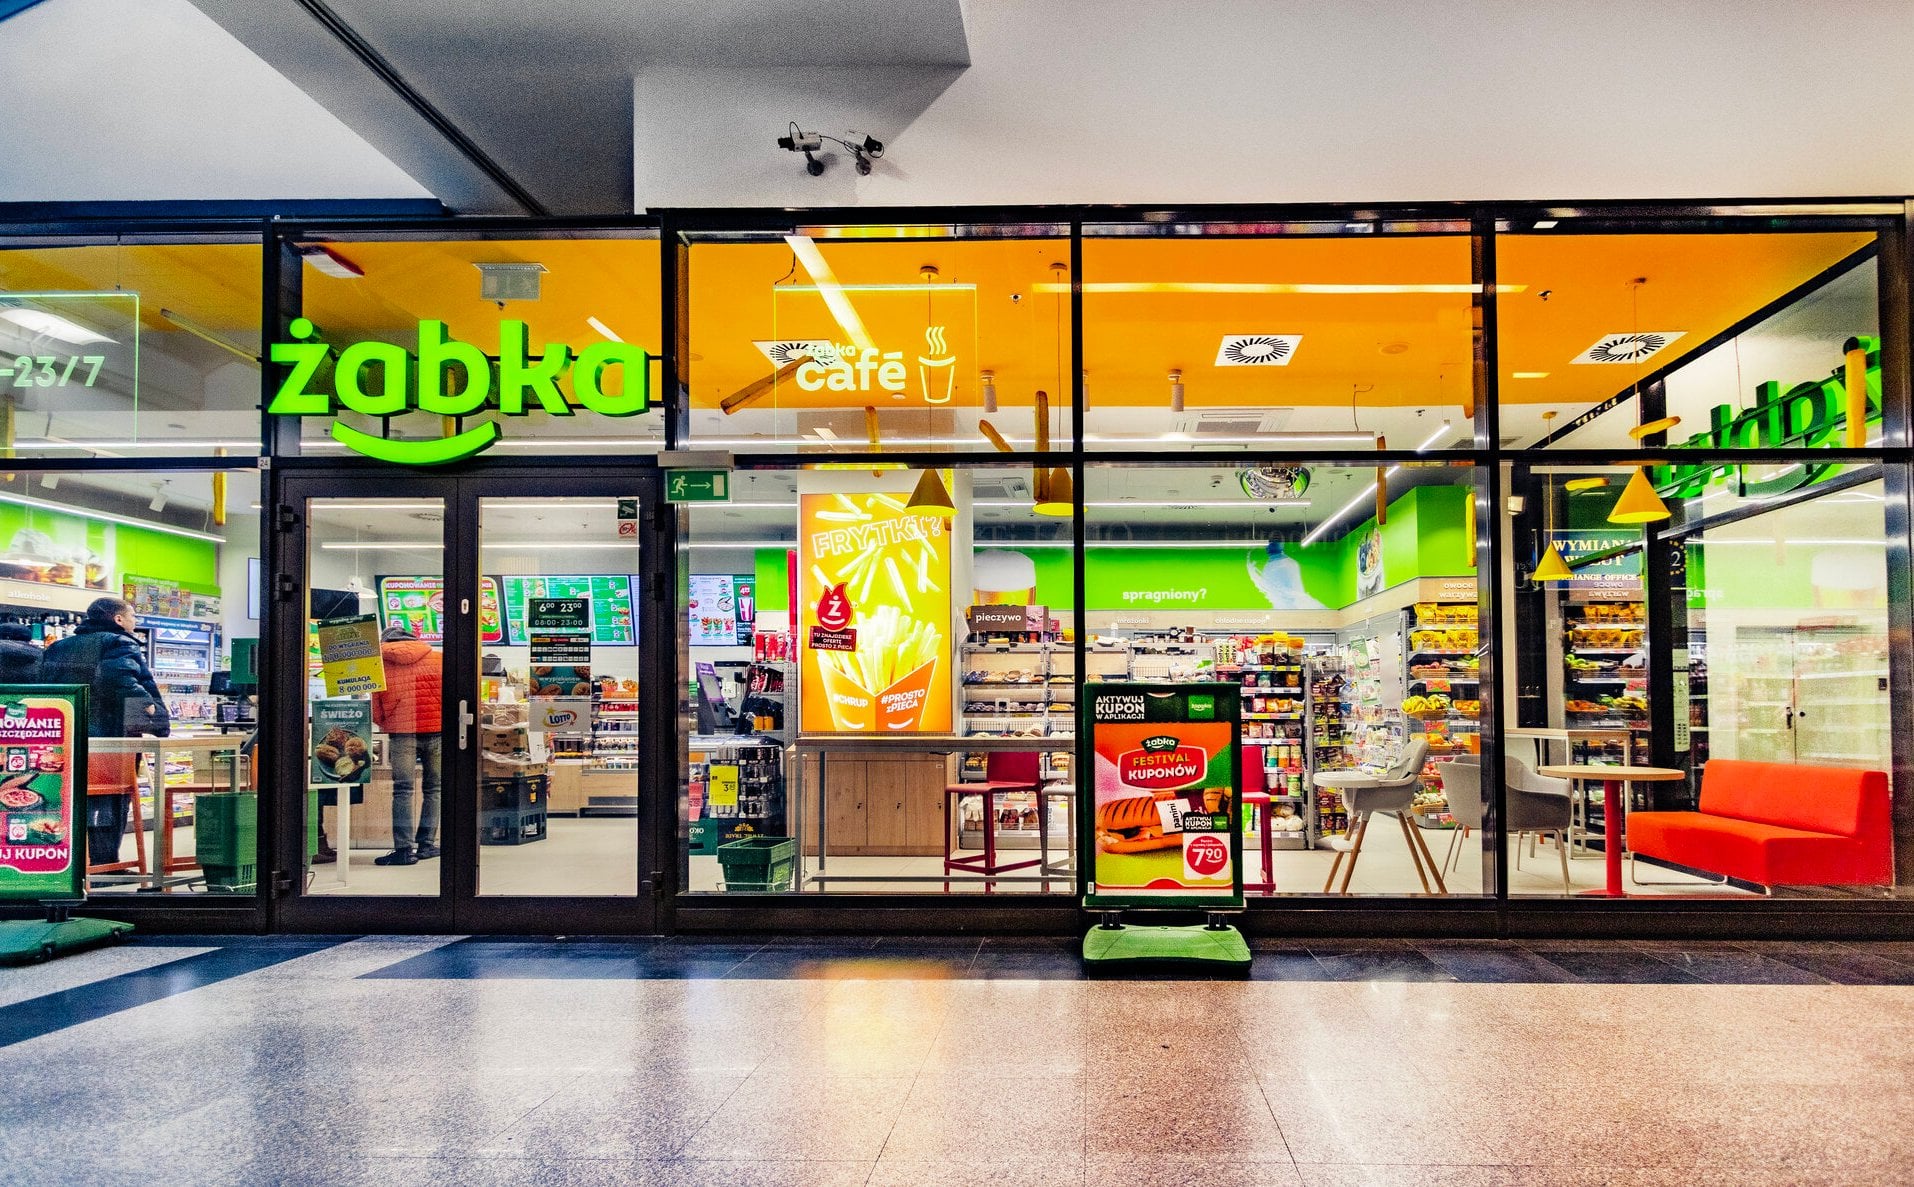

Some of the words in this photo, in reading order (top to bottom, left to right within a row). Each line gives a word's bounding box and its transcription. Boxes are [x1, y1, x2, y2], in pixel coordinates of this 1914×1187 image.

[268, 318, 650, 417] żabka
[796, 347, 906, 391] café
[812, 515, 942, 559] FRYTKI?
[1552, 539, 1631, 551] WYMIAN
[1122, 588, 1207, 603] spragniony?
[975, 612, 1022, 623] pieczywo
[880, 688, 926, 704] #PROSTO
[1095, 695, 1144, 704] AKTYWUJ
[321, 708, 364, 719] ŚWIEŻO
[1095, 703, 1145, 714] KUPON
[549, 714, 571, 724] LOTTO
[1145, 737, 1176, 748] żabka
[1133, 753, 1190, 767] FESTIVAL
[1128, 764, 1197, 781] KUPONÓW
[1167, 803, 1183, 829] panini
[15, 848, 67, 860] KUPON
